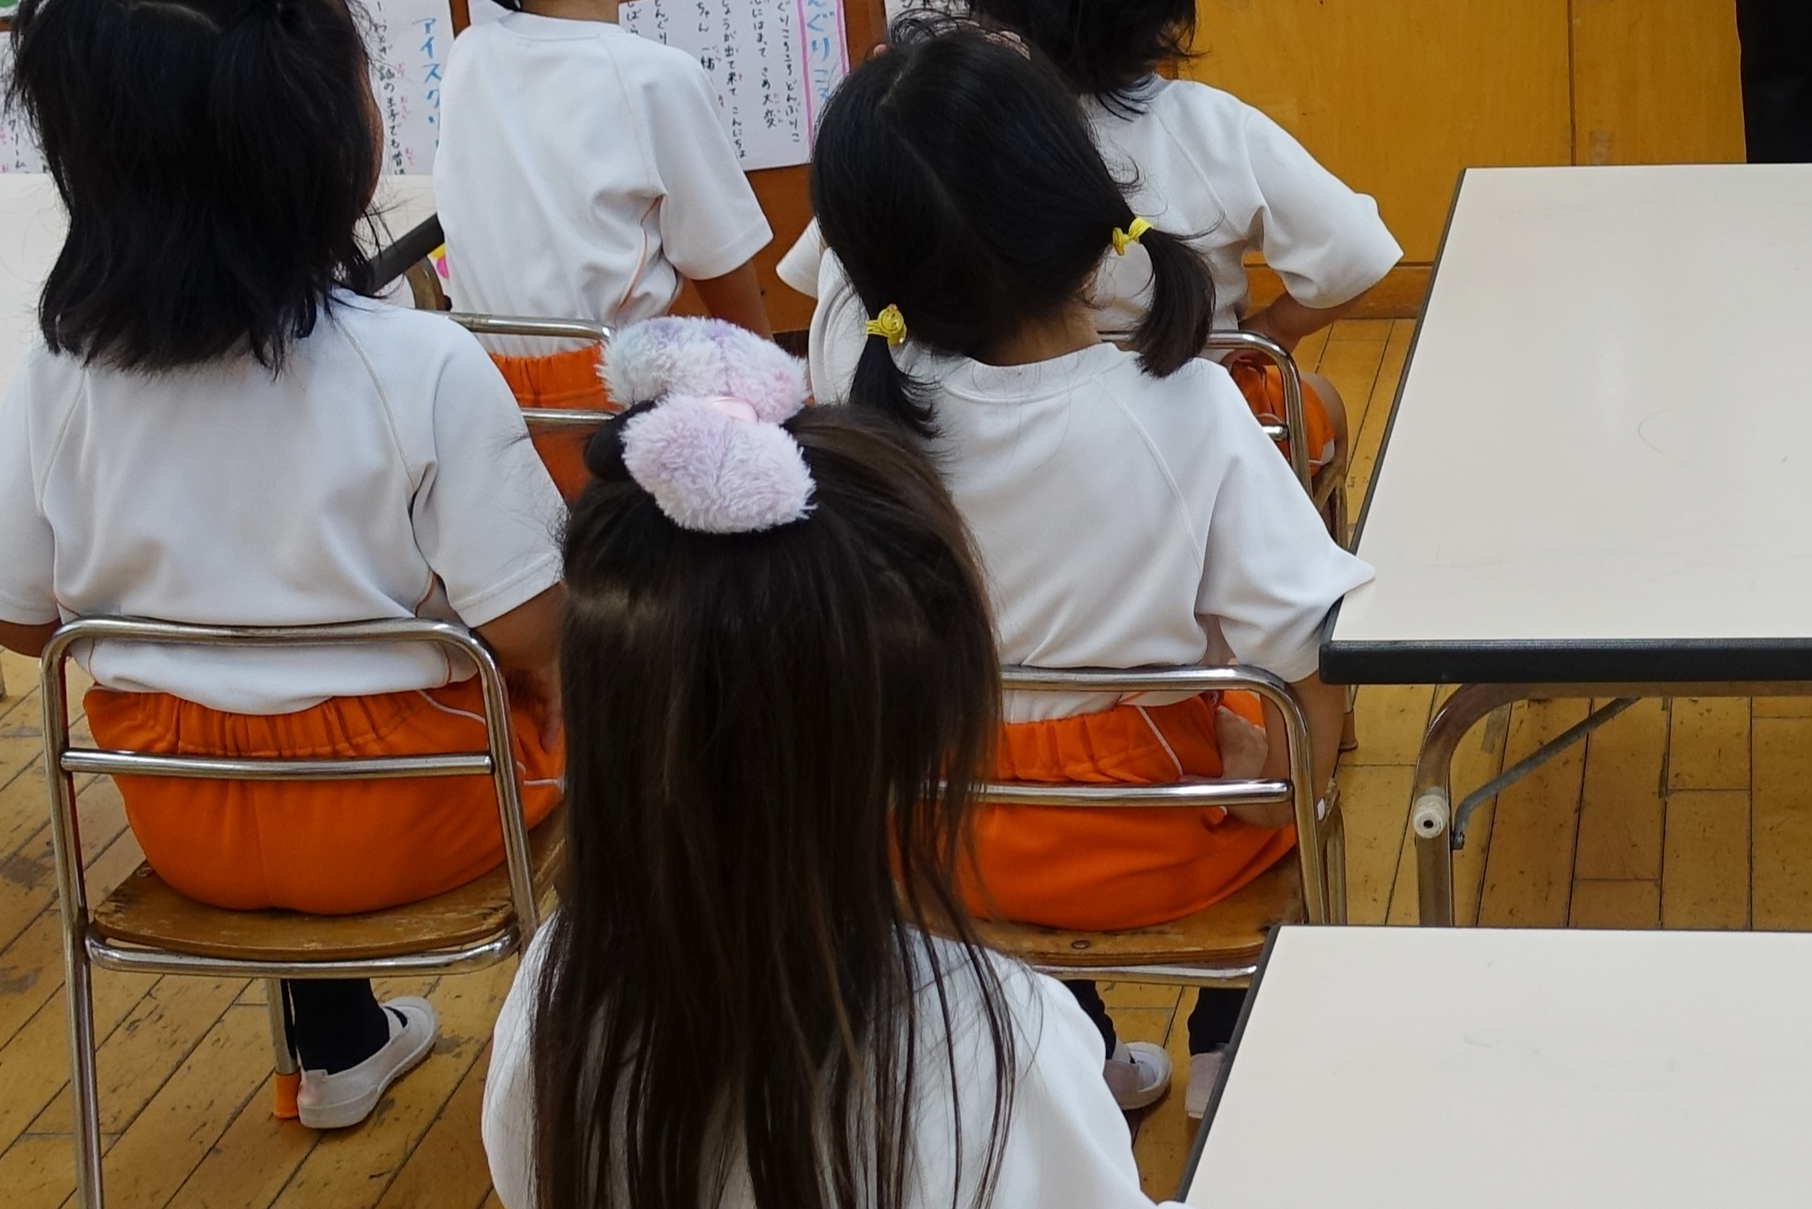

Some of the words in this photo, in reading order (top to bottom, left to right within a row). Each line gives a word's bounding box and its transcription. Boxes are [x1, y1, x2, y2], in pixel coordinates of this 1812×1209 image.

[412, 18, 444, 149] アイスクリ
